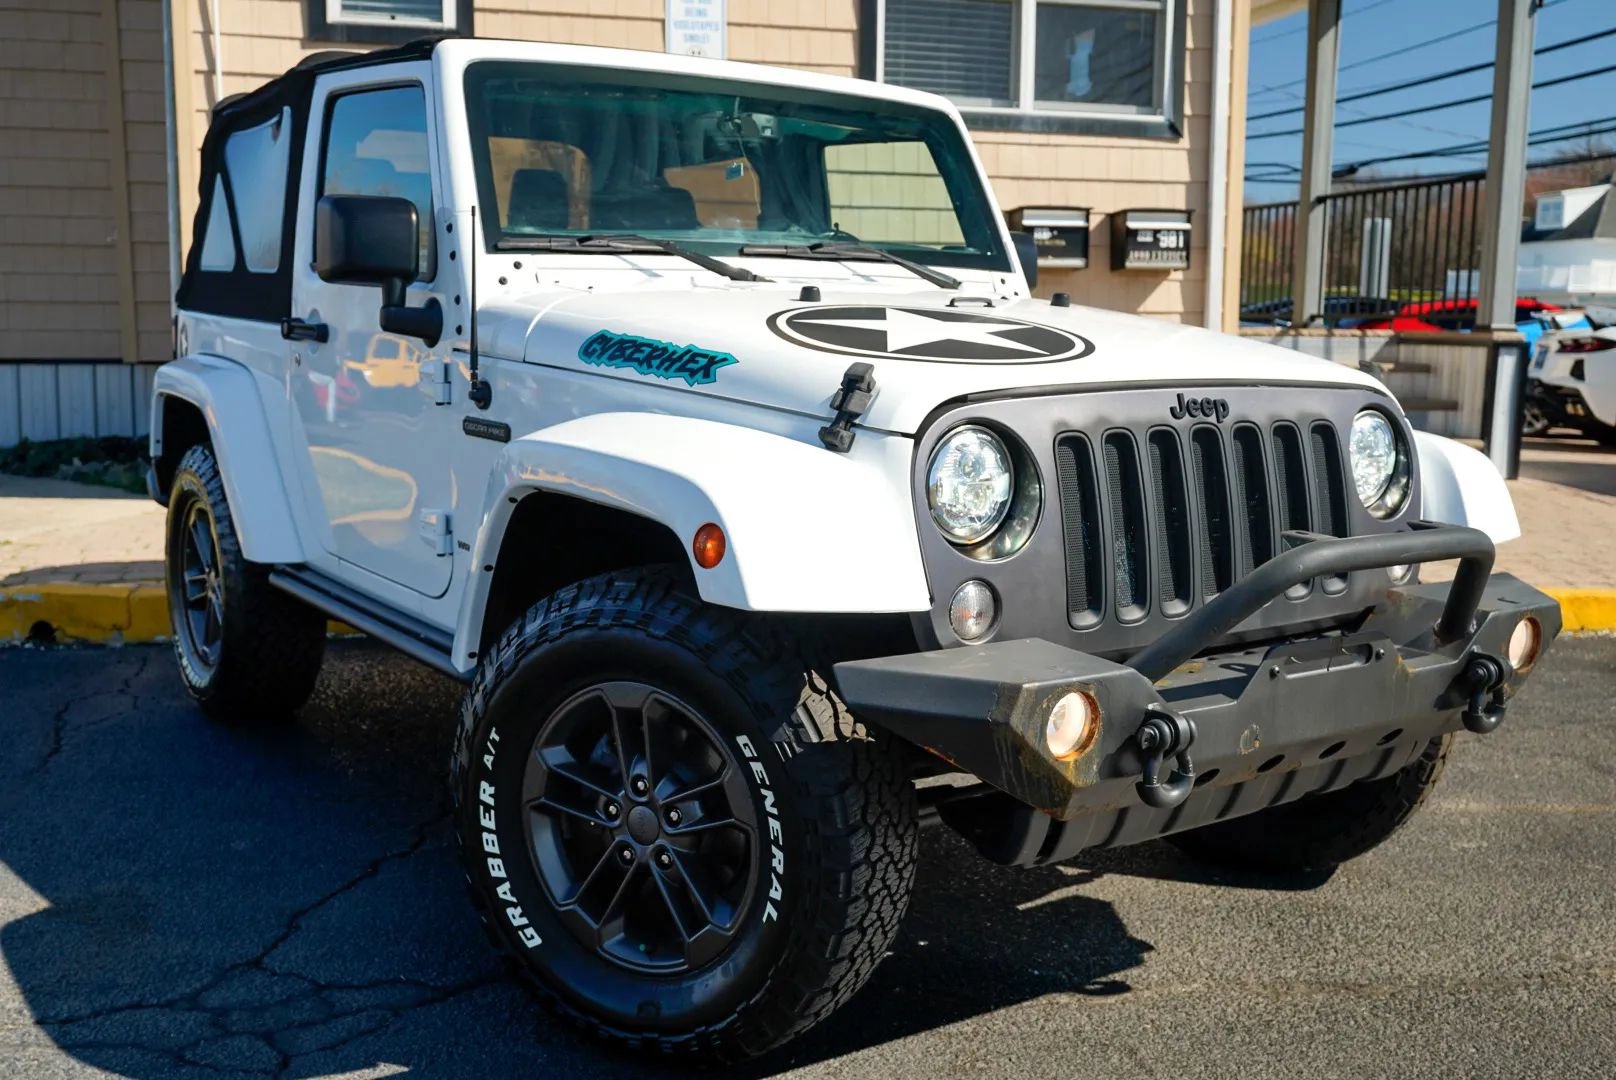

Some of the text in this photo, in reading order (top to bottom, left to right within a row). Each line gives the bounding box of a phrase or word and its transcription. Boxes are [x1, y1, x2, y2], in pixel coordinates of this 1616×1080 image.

[581, 333, 730, 379] CYBERHEX
[1169, 392, 1230, 423] Jeep
[479, 726, 543, 949] GRABBER A/T
[735, 734, 785, 925] GENERAL
